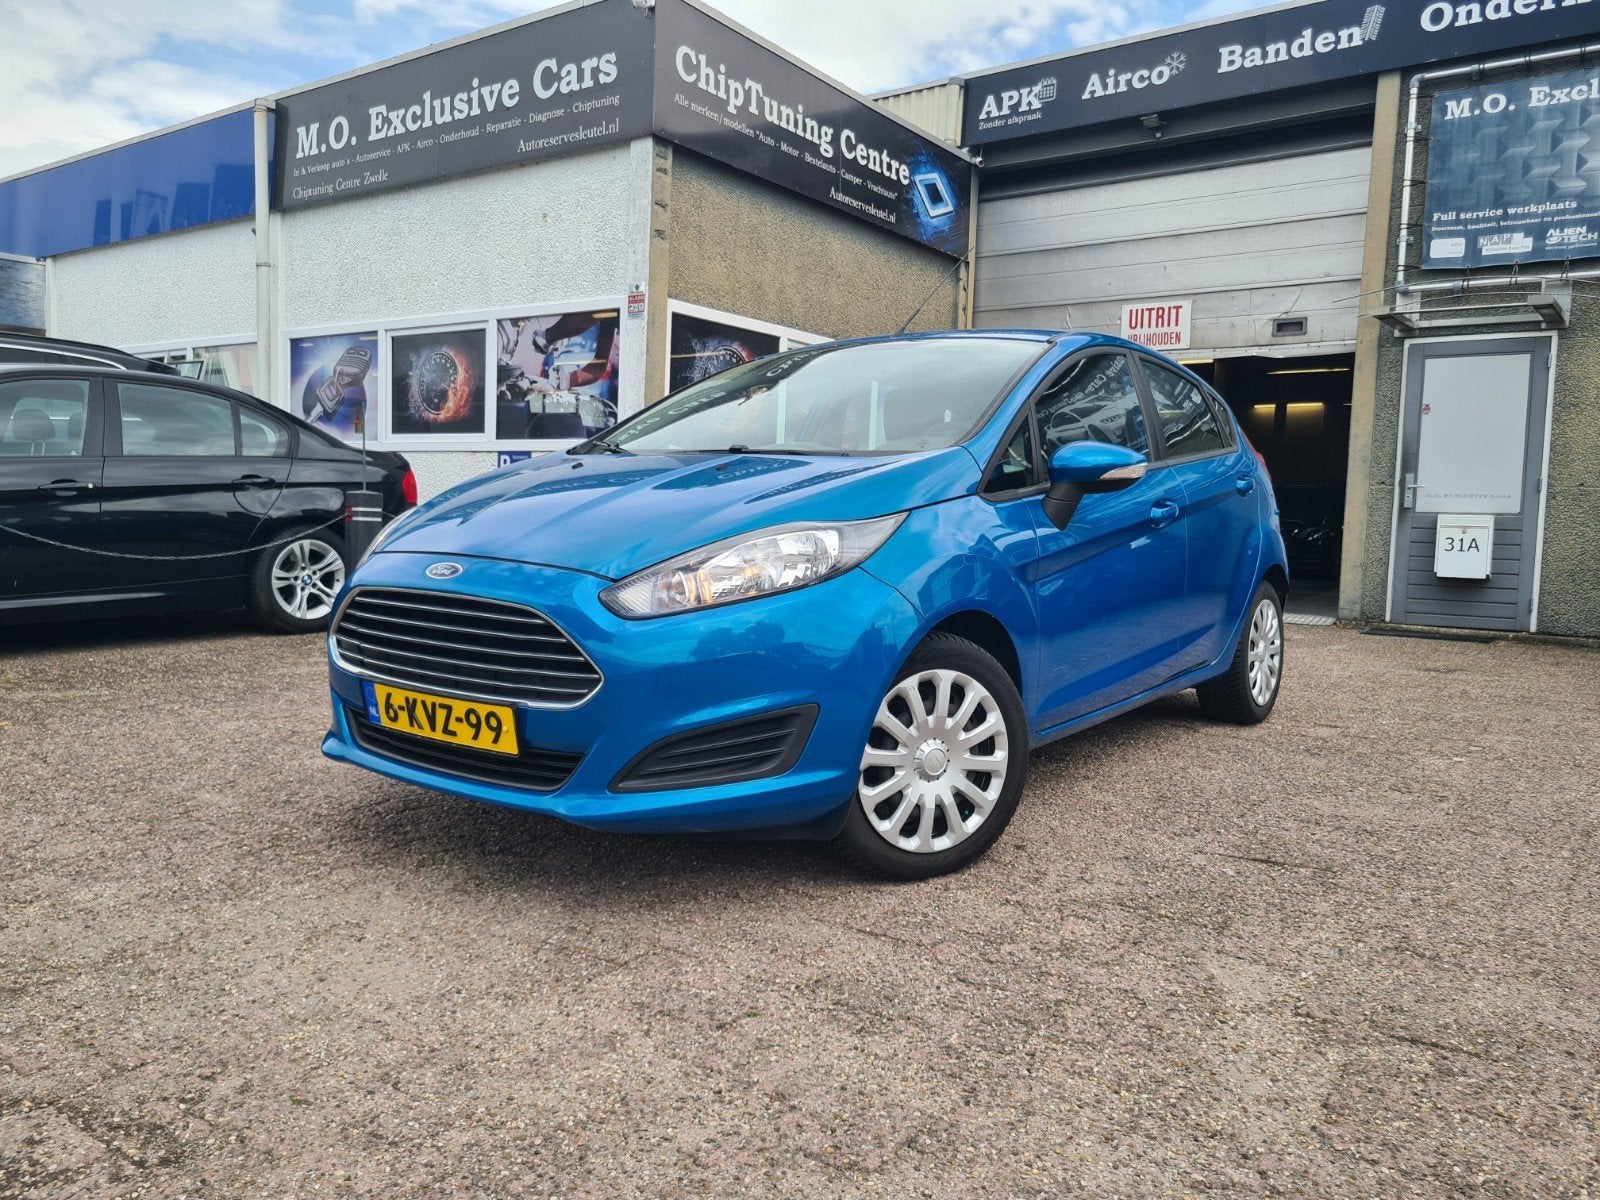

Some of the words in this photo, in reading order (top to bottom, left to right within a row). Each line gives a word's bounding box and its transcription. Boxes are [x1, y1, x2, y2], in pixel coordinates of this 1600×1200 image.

[1420, 0, 1592, 32] Onde
[1216, 24, 1363, 74] Banden
[1081, 69, 1170, 100] Airco
[1444, 93, 1515, 120] M.O.
[1528, 78, 1600, 107] Excl
[295, 116, 357, 159] M.O.
[368, 77, 520, 142] Exclusive
[532, 52, 618, 99] Cars
[675, 45, 834, 159] ChipTuning
[840, 129, 910, 185] Centre
[978, 83, 1042, 120] APK
[293, 168, 300, 177] In
[307, 162, 331, 174] Verkoop
[355, 149, 391, 164] Autoservice
[396, 142, 410, 154] APK
[416, 137, 433, 150] Airco
[440, 126, 479, 144] Onderhoud
[486, 116, 522, 134] Reparatie
[529, 108, 565, 124] Diagnose
[572, 94, 620, 114] Chiptuning
[517, 118, 620, 153] Autoreservesleutel.nl
[978, 117, 1005, 130] Zonder
[1007, 111, 1042, 125] afspraak
[673, 93, 689, 108] Alle
[780, 141, 800, 158] Motor
[804, 152, 836, 174] Bestelauto
[840, 169, 863, 186] Camper
[292, 183, 334, 200] Chiptuning
[335, 177, 361, 192] Centre
[364, 168, 389, 186] Zwolle
[829, 186, 896, 224] Autoreservesleutel.nl
[1432, 211, 1456, 222] Full
[1459, 207, 1504, 219] service
[1507, 200, 1578, 214] werkplaats
[1480, 234, 1511, 246] NAP
[1546, 226, 1587, 237] ALIEN
[1561, 232, 1598, 243] TECH
[1129, 305, 1183, 330] UITRIT
[1444, 537, 1480, 552] 31A
[369, 705, 379, 717] NL
[384, 691, 503, 745] 6-KVZ-99
